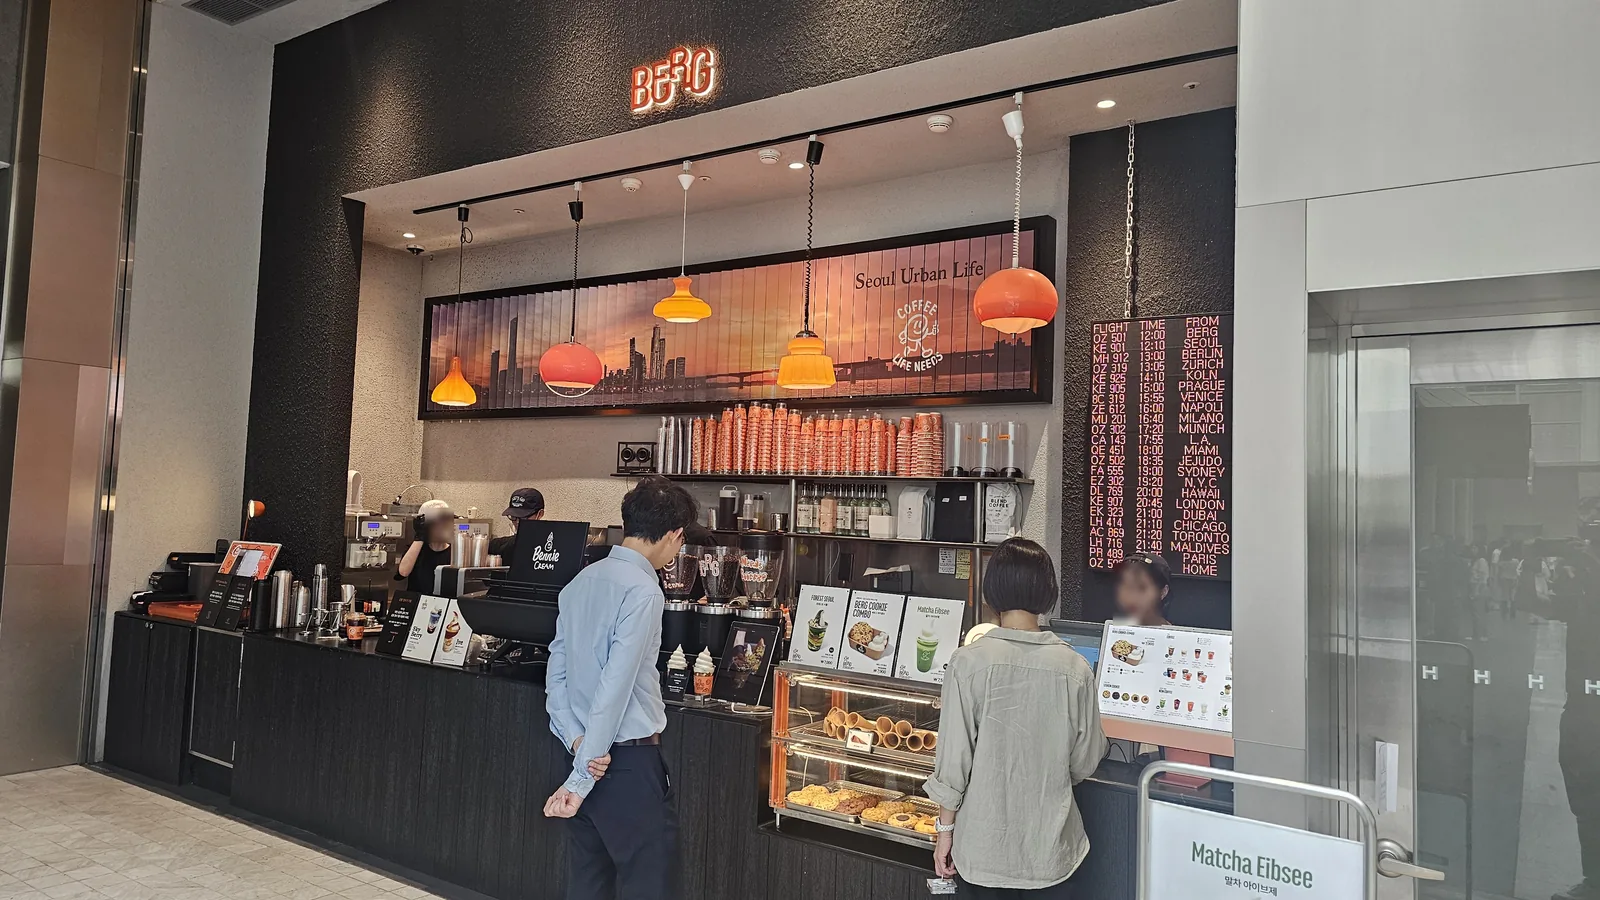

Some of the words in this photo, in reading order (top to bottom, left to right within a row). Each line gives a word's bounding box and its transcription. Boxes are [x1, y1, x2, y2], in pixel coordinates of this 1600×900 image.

[631, 46, 713, 111] BERG
[856, 271, 895, 289] Seoul
[901, 267, 947, 284] Urban
[953, 261, 983, 278] Life
[897, 300, 937, 319] COFFEE
[1094, 322, 1130, 333] FLIGHT
[1139, 320, 1165, 330] TIME
[1186, 316, 1219, 327] FROM
[1094, 334, 1107, 343] OZ
[1111, 332, 1125, 342] 501
[1140, 330, 1165, 340] 12:00
[1187, 327, 1218, 338] BERG
[1094, 344, 1106, 353] KE
[1111, 343, 1124, 352] 901
[1140, 341, 1165, 350] 12:10
[1184, 338, 1222, 348] SEOUL
[892, 354, 912, 371] LIFE
[914, 352, 943, 372] NEEDS
[1093, 354, 1109, 363] MH
[1113, 353, 1129, 362] 912
[1140, 351, 1165, 361] 13:00
[1182, 348, 1222, 359] BERLIN
[1093, 364, 1106, 373] OZ
[1111, 362, 1128, 372] 319
[1140, 362, 1165, 371] 13:05
[1093, 374, 1106, 383] KE
[1110, 373, 1125, 383] 925
[1139, 372, 1164, 382] 14:10
[1092, 384, 1105, 393] KE
[1110, 384, 1125, 393] 905
[1139, 382, 1164, 392] 15:00
[1179, 380, 1225, 391] PRAGUE
[1109, 394, 1124, 403] 319
[1139, 392, 1164, 402] 15:55
[1181, 391, 1223, 402] VENICE
[1092, 404, 1105, 414] ZE
[1109, 404, 1125, 413] 612
[1139, 403, 1164, 413] 16:00
[1181, 402, 1223, 412] NAPOLI
[1092, 415, 1107, 424] MU
[1111, 414, 1126, 423] 201
[1139, 414, 1164, 423] 16:40
[1179, 413, 1223, 423] MILANO
[1092, 425, 1105, 434] OZ
[1110, 425, 1125, 434] 302
[1138, 424, 1163, 434] 17:20
[1179, 424, 1224, 434] MUNICH
[1092, 435, 1106, 444] CA
[1110, 435, 1125, 444] 143
[1138, 435, 1163, 444] 17:55
[1109, 446, 1124, 455] 451
[1138, 446, 1163, 455] 18:00
[1184, 446, 1218, 455] MIAMI
[1091, 456, 1105, 465] OZ
[1109, 456, 1125, 465] 502
[1138, 456, 1163, 465] 18:35
[1179, 456, 1222, 466] JEJUDO
[1091, 466, 1104, 475] FA
[1107, 466, 1123, 475] 555
[1138, 466, 1163, 476] 19:00
[1178, 467, 1225, 477] SYDNEY
[1091, 476, 1103, 486] EZ
[1108, 476, 1124, 486] 302
[1138, 477, 1163, 486] 19:20
[1090, 486, 1103, 496] DL
[1107, 487, 1123, 496] 769
[1137, 487, 1162, 497] 20:00
[1182, 488, 1219, 499] HAWAII
[1090, 497, 1103, 506] KE
[1107, 497, 1123, 506] 907
[1137, 498, 1162, 508] 20:45
[1176, 499, 1224, 510] LONDON
[1090, 507, 1104, 516] EK
[1108, 507, 1123, 517] 323
[1136, 508, 1162, 518] 21:00
[1183, 510, 1216, 520] DUBAI
[1090, 517, 1102, 526] LH
[1107, 518, 1122, 527] 414
[1136, 519, 1162, 529] 21:10
[1174, 520, 1226, 532] CHICAGO
[1090, 528, 1103, 537] AC
[1108, 528, 1124, 537] 869
[1136, 530, 1162, 539] 21:20
[1172, 531, 1229, 543] TORONTO
[1090, 538, 1102, 547] LH
[1107, 538, 1122, 548] 716
[1136, 540, 1162, 550] 21:40
[1171, 542, 1229, 554] MALDIVES
[532, 546, 560, 562] Bennie
[1089, 548, 1103, 557] PR
[1107, 549, 1123, 558] 489
[1183, 553, 1216, 564] PARIS
[1090, 558, 1103, 568] OZ
[1183, 564, 1217, 576] HOME
[854, 600, 868, 610] BERG
[868, 602, 888, 611] COOKIE
[917, 606, 934, 614] Matcha
[853, 609, 872, 618] COMBO
[1192, 841, 1252, 876] Matcha
[1257, 856, 1313, 889] Eibsee
[1225, 876, 1241, 888] 말차
[1244, 880, 1277, 896] 아이브제
